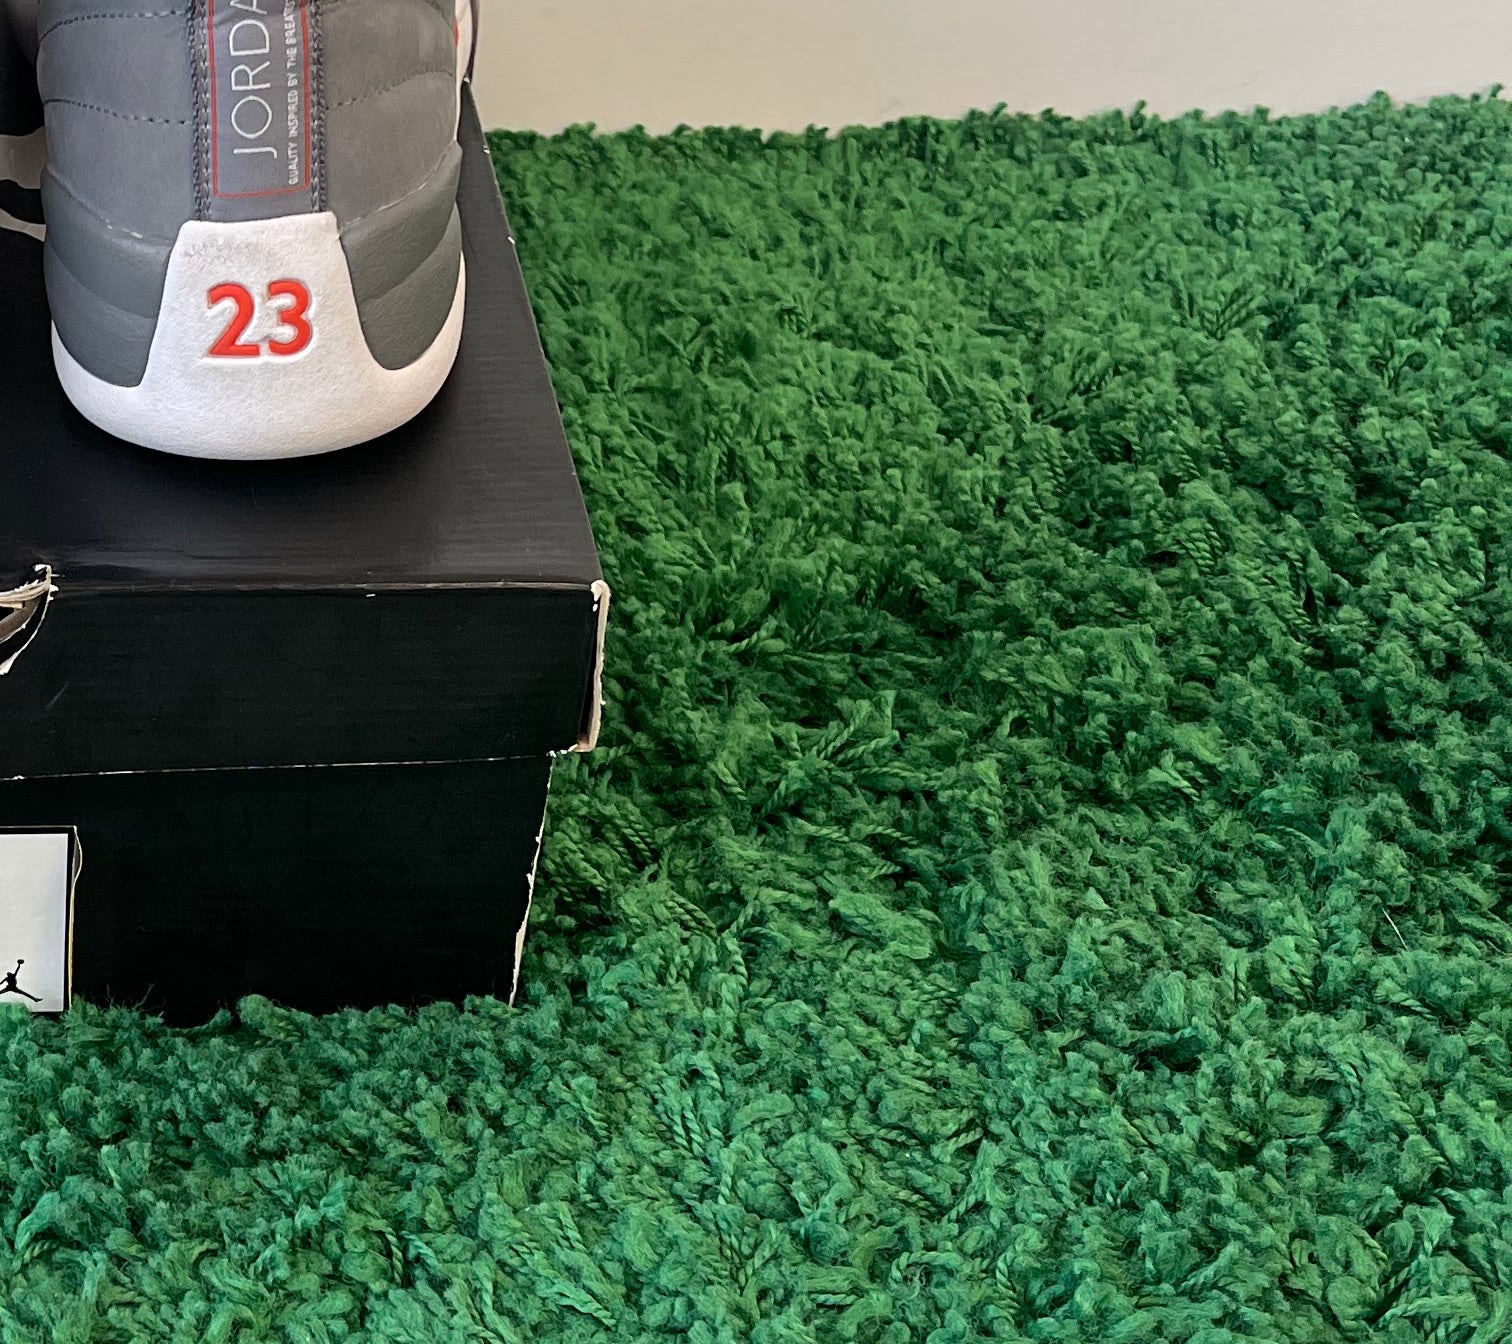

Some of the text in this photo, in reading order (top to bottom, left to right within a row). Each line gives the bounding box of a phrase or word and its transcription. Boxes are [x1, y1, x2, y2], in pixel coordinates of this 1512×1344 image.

[286, 47, 297, 68] THE
[286, 72, 299, 87] BY
[287, 89, 299, 138] INSPIRED
[287, 142, 299, 185] QUALITY
[206, 277, 313, 357] 23
